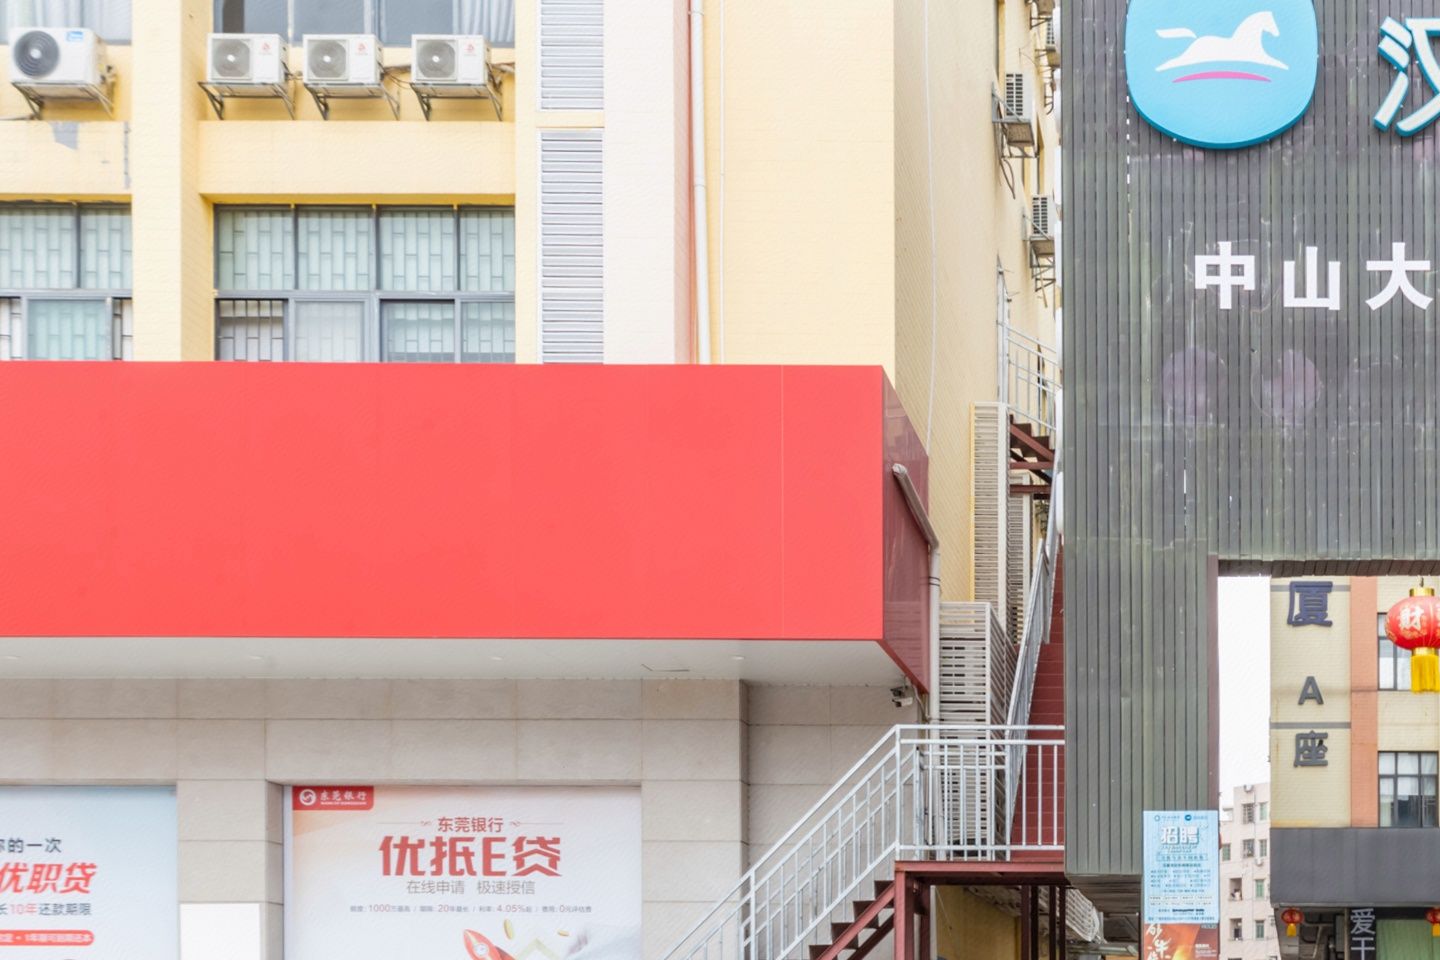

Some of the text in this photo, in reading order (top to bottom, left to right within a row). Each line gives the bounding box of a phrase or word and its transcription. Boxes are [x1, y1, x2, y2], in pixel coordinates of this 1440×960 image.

[1287, 581, 1333, 767] 厦 A座
[437, 817, 503, 832] 东莞银行
[1161, 826, 1200, 845] 招聘
[379, 835, 562, 877] 优抵E贷
[0, 862, 97, 894] 优职贷
[406, 880, 536, 895] 在线申请 极速授信
